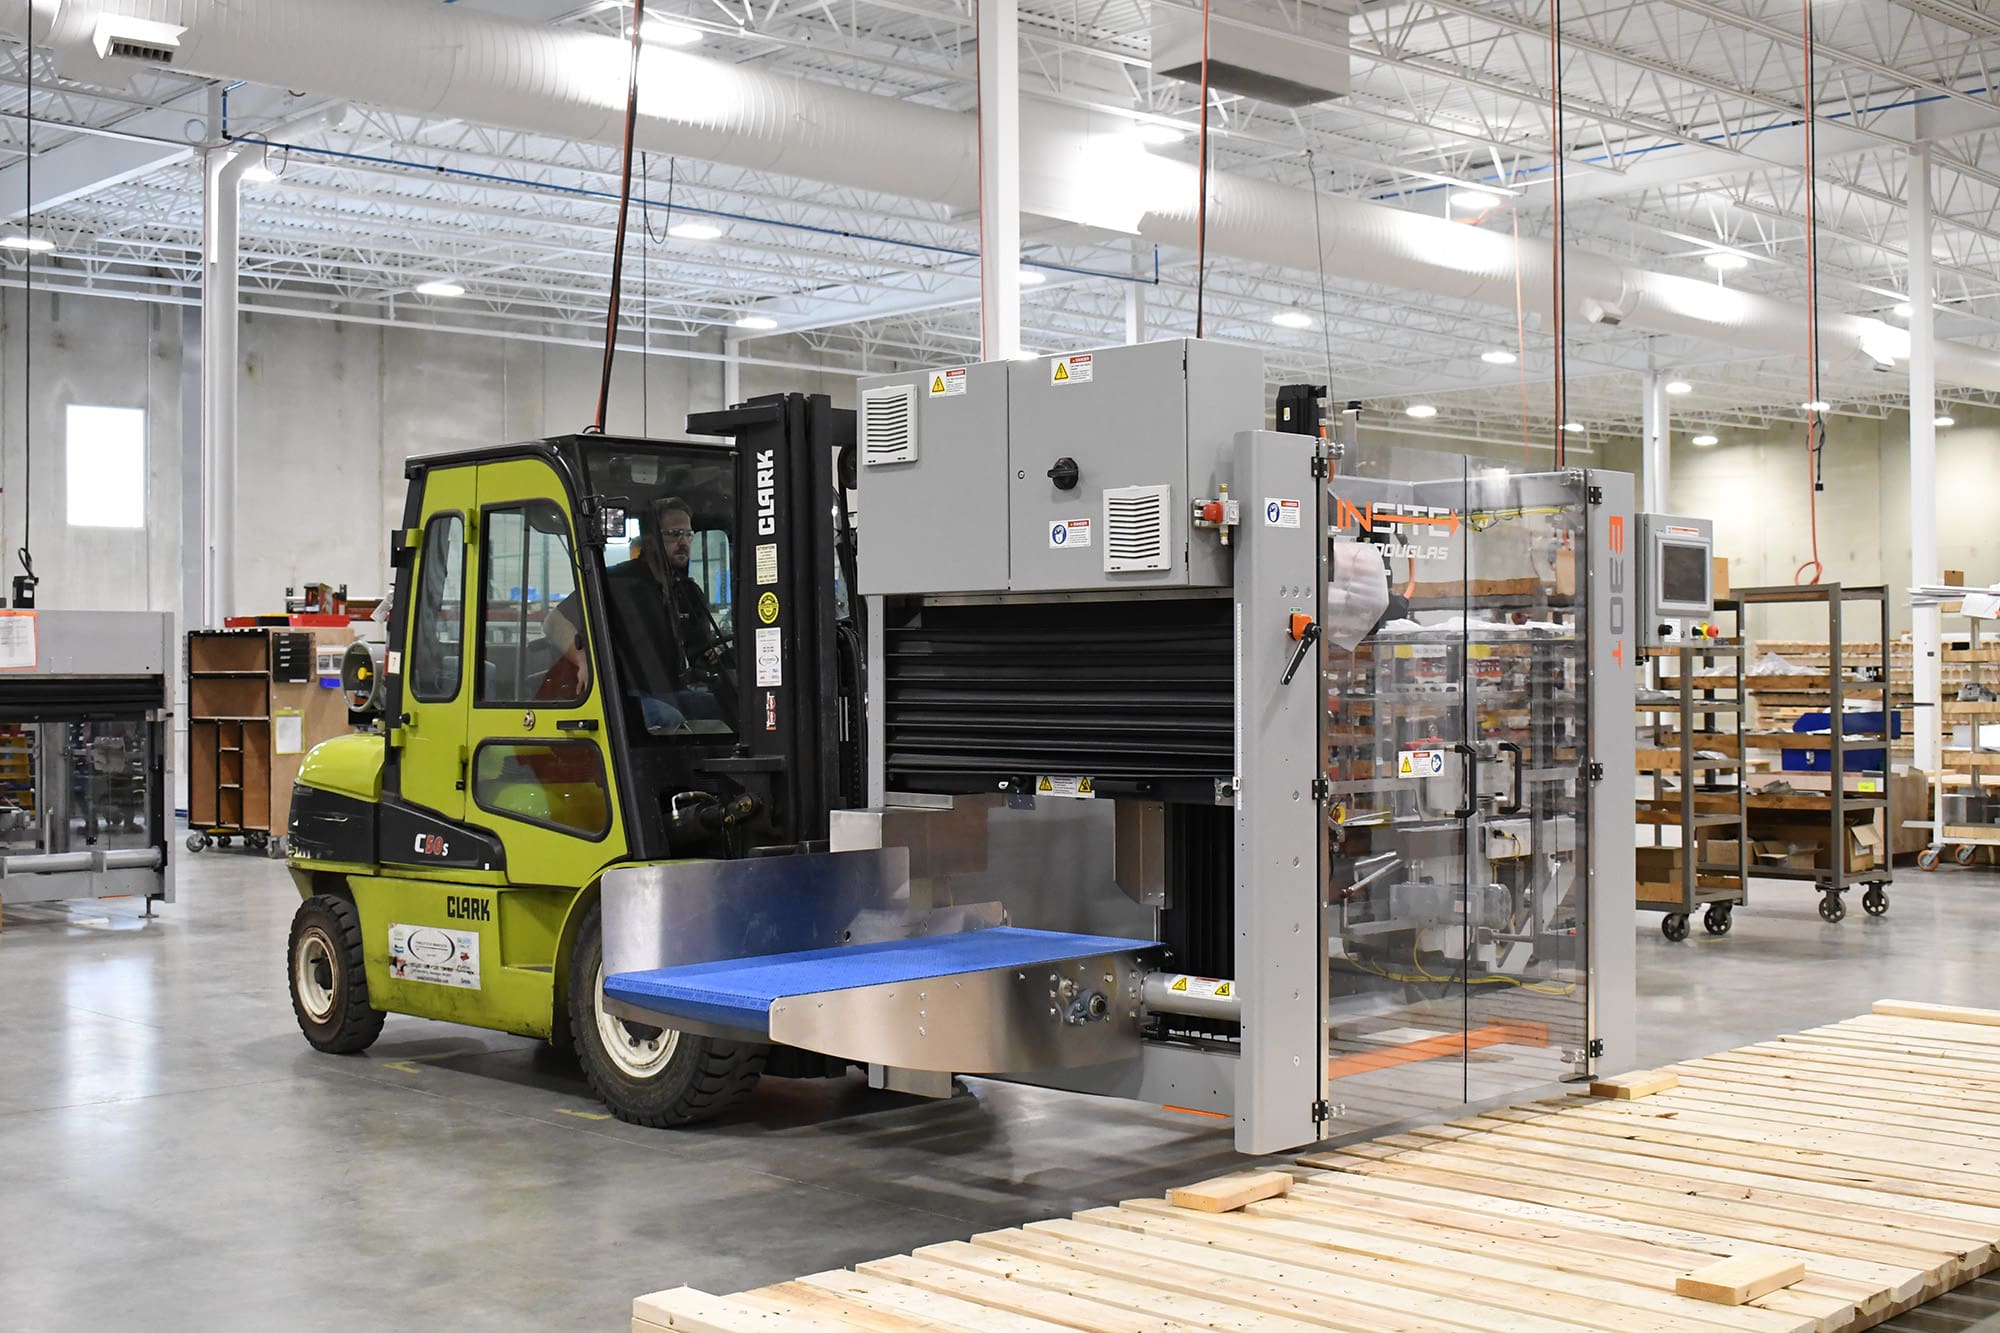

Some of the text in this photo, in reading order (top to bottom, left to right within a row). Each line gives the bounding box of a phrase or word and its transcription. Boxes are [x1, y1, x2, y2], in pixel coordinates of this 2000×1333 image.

[757, 449, 775, 536] CLARK
[1337, 498, 1449, 537] INSITE
[447, 896, 490, 922] CLARK
